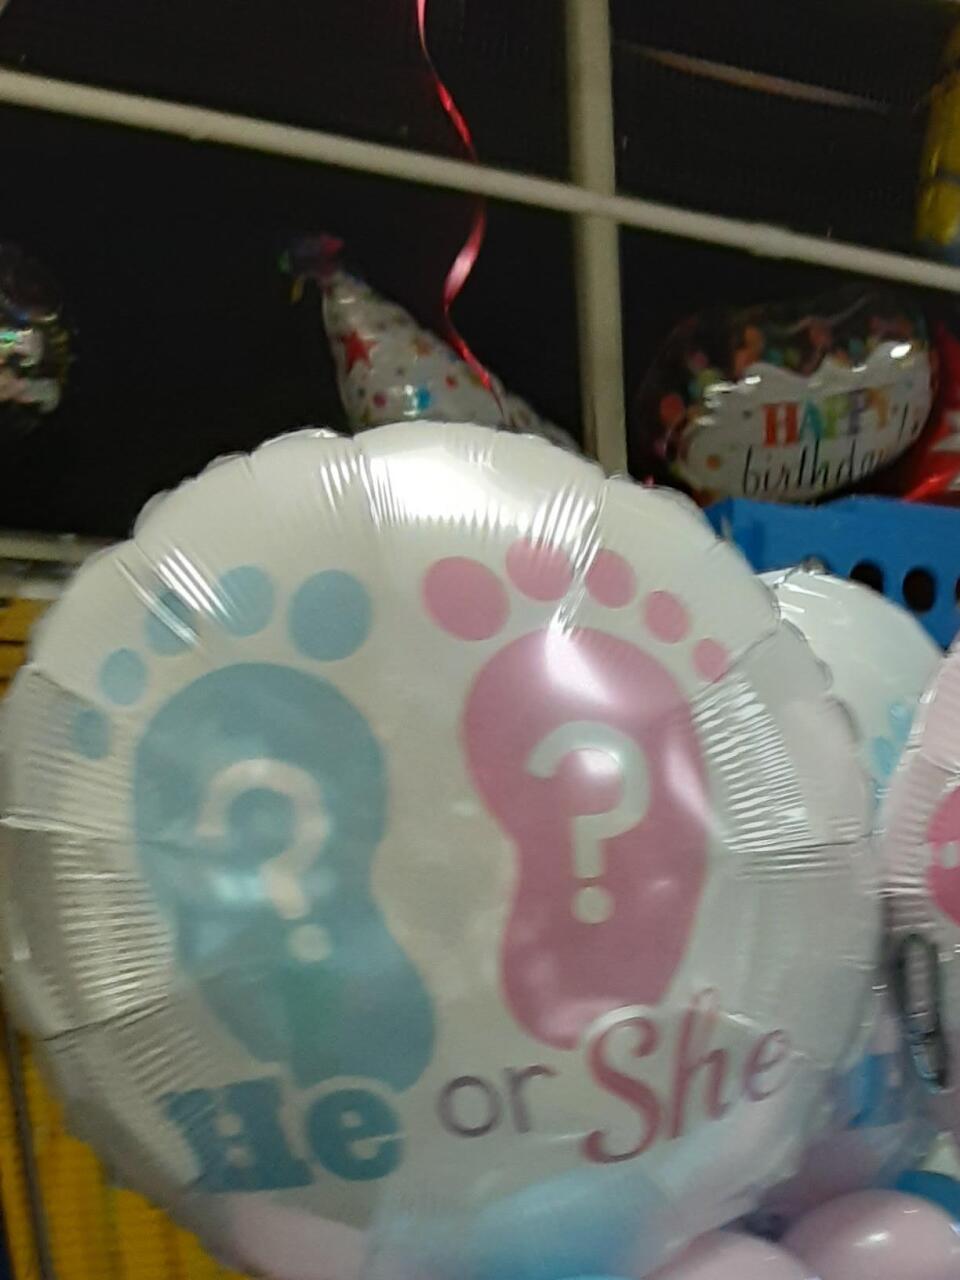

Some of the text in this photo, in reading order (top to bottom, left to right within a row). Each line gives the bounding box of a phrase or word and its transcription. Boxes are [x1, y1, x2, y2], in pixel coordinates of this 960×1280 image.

[761, 385, 892, 448] HAPPY
[160, 1074, 402, 1192] He
[437, 1061, 558, 1139] or
[580, 993, 792, 1166] She
